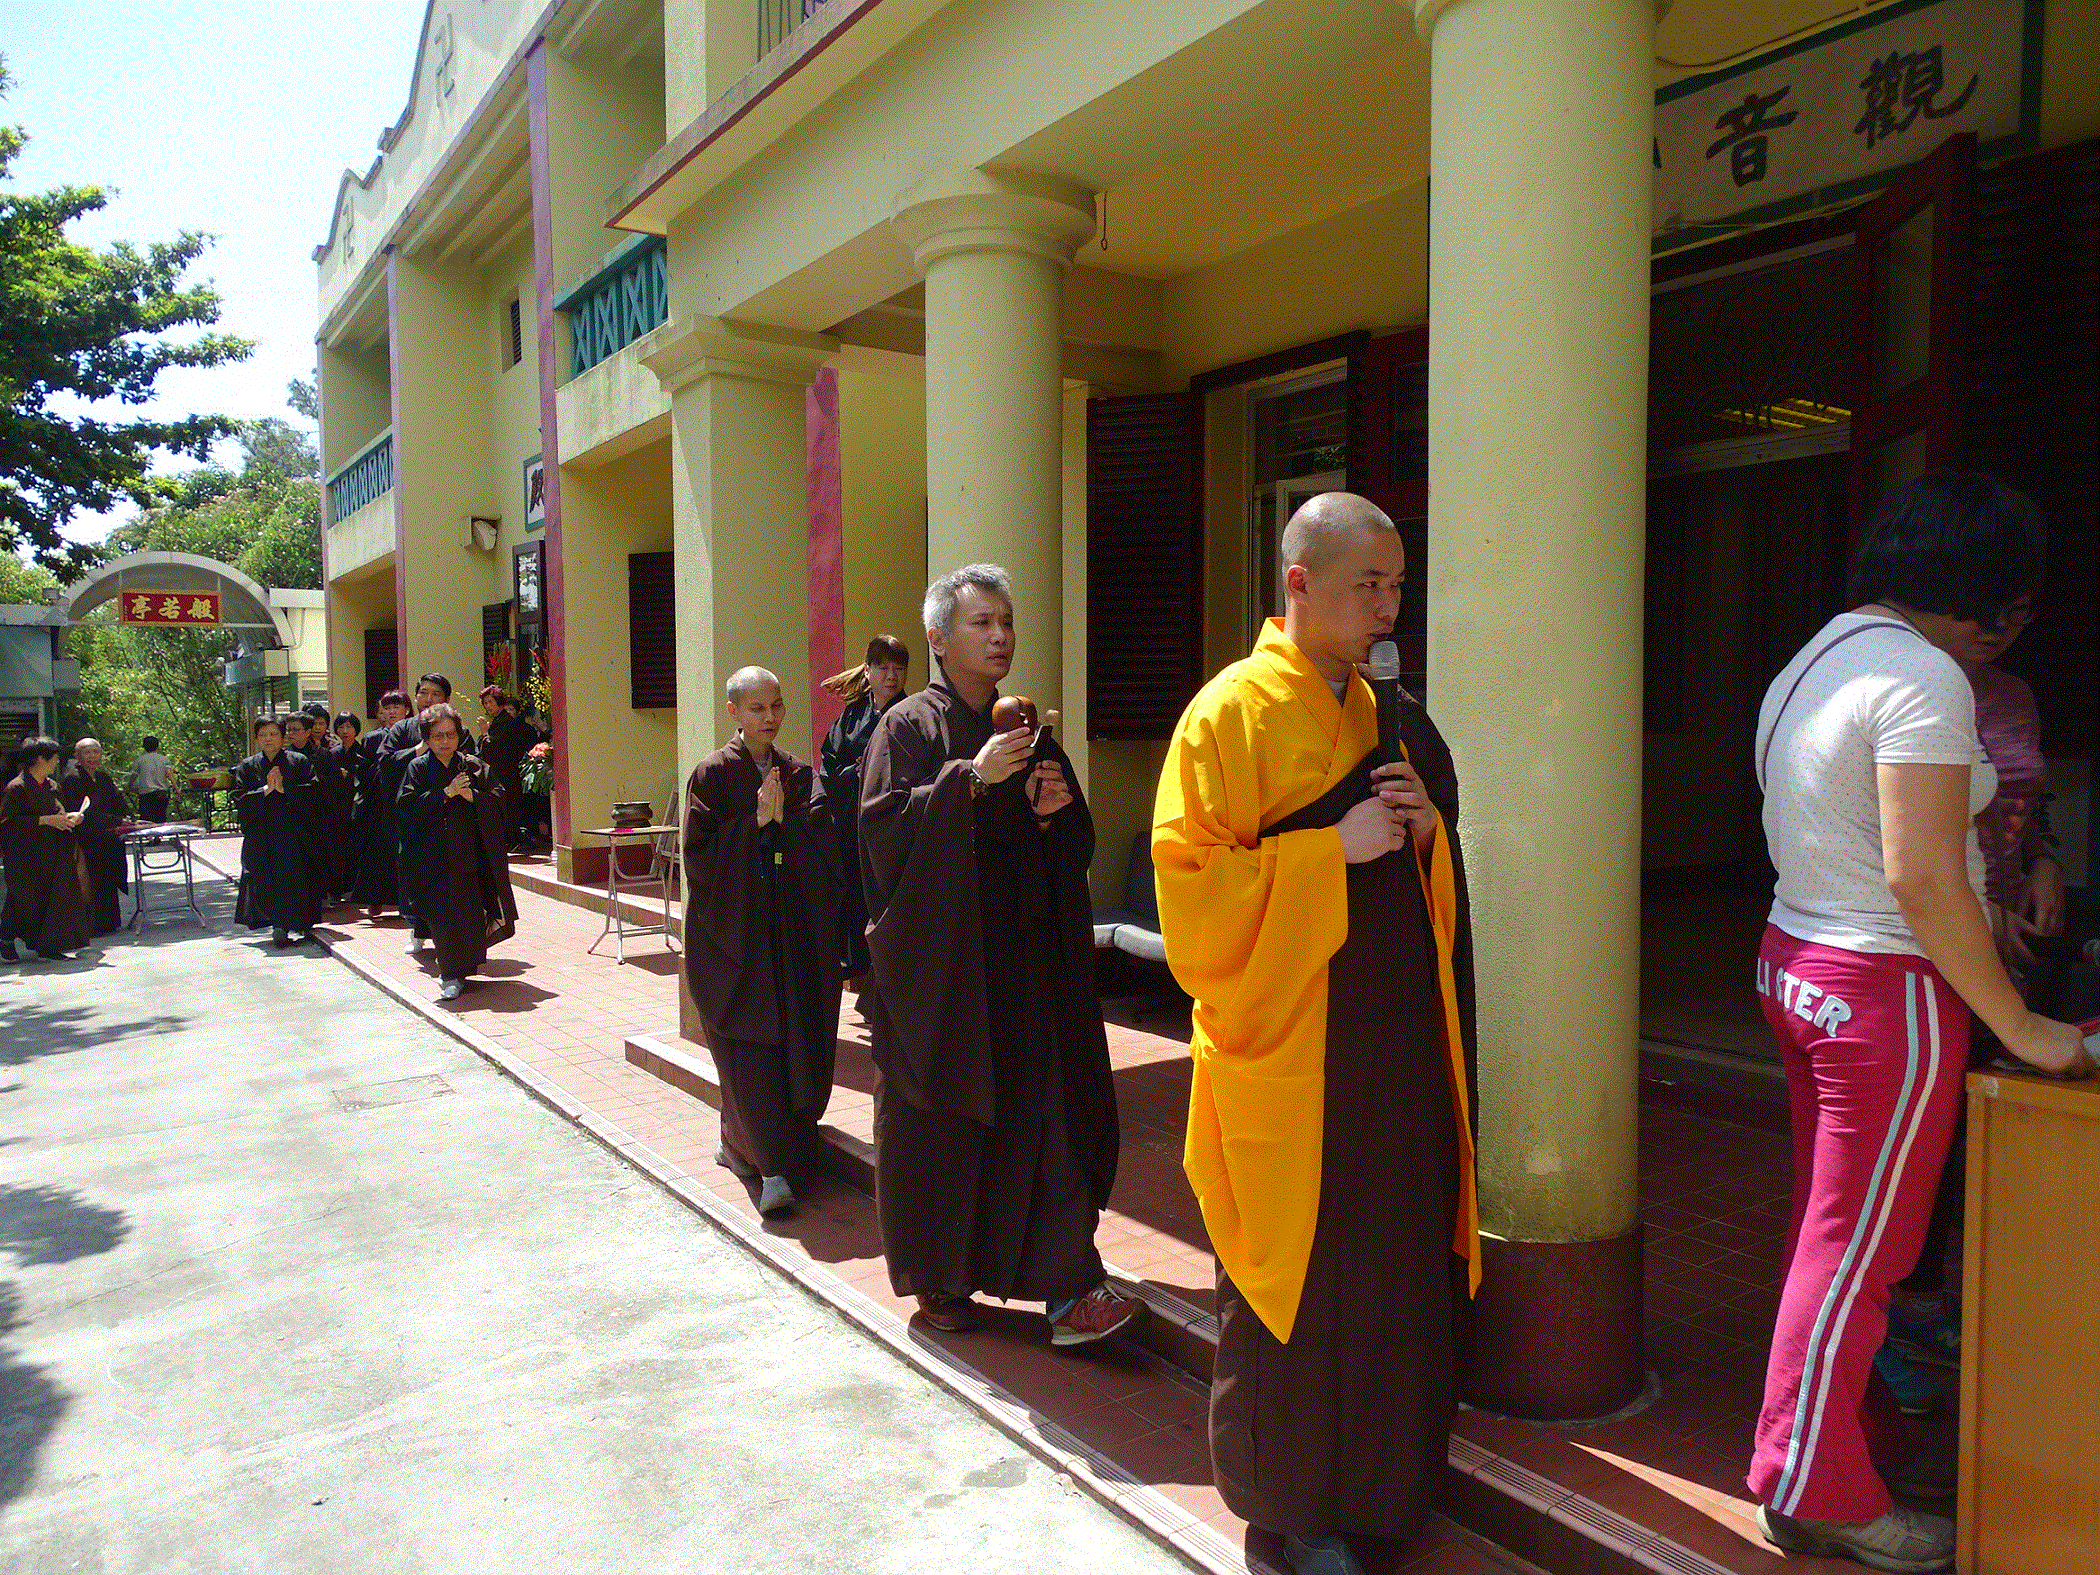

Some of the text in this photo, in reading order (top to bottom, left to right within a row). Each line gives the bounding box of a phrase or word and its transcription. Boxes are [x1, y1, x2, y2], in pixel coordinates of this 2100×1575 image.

[1654, 45, 1979, 187] 觀音
[131, 595, 215, 620] 般若亭
